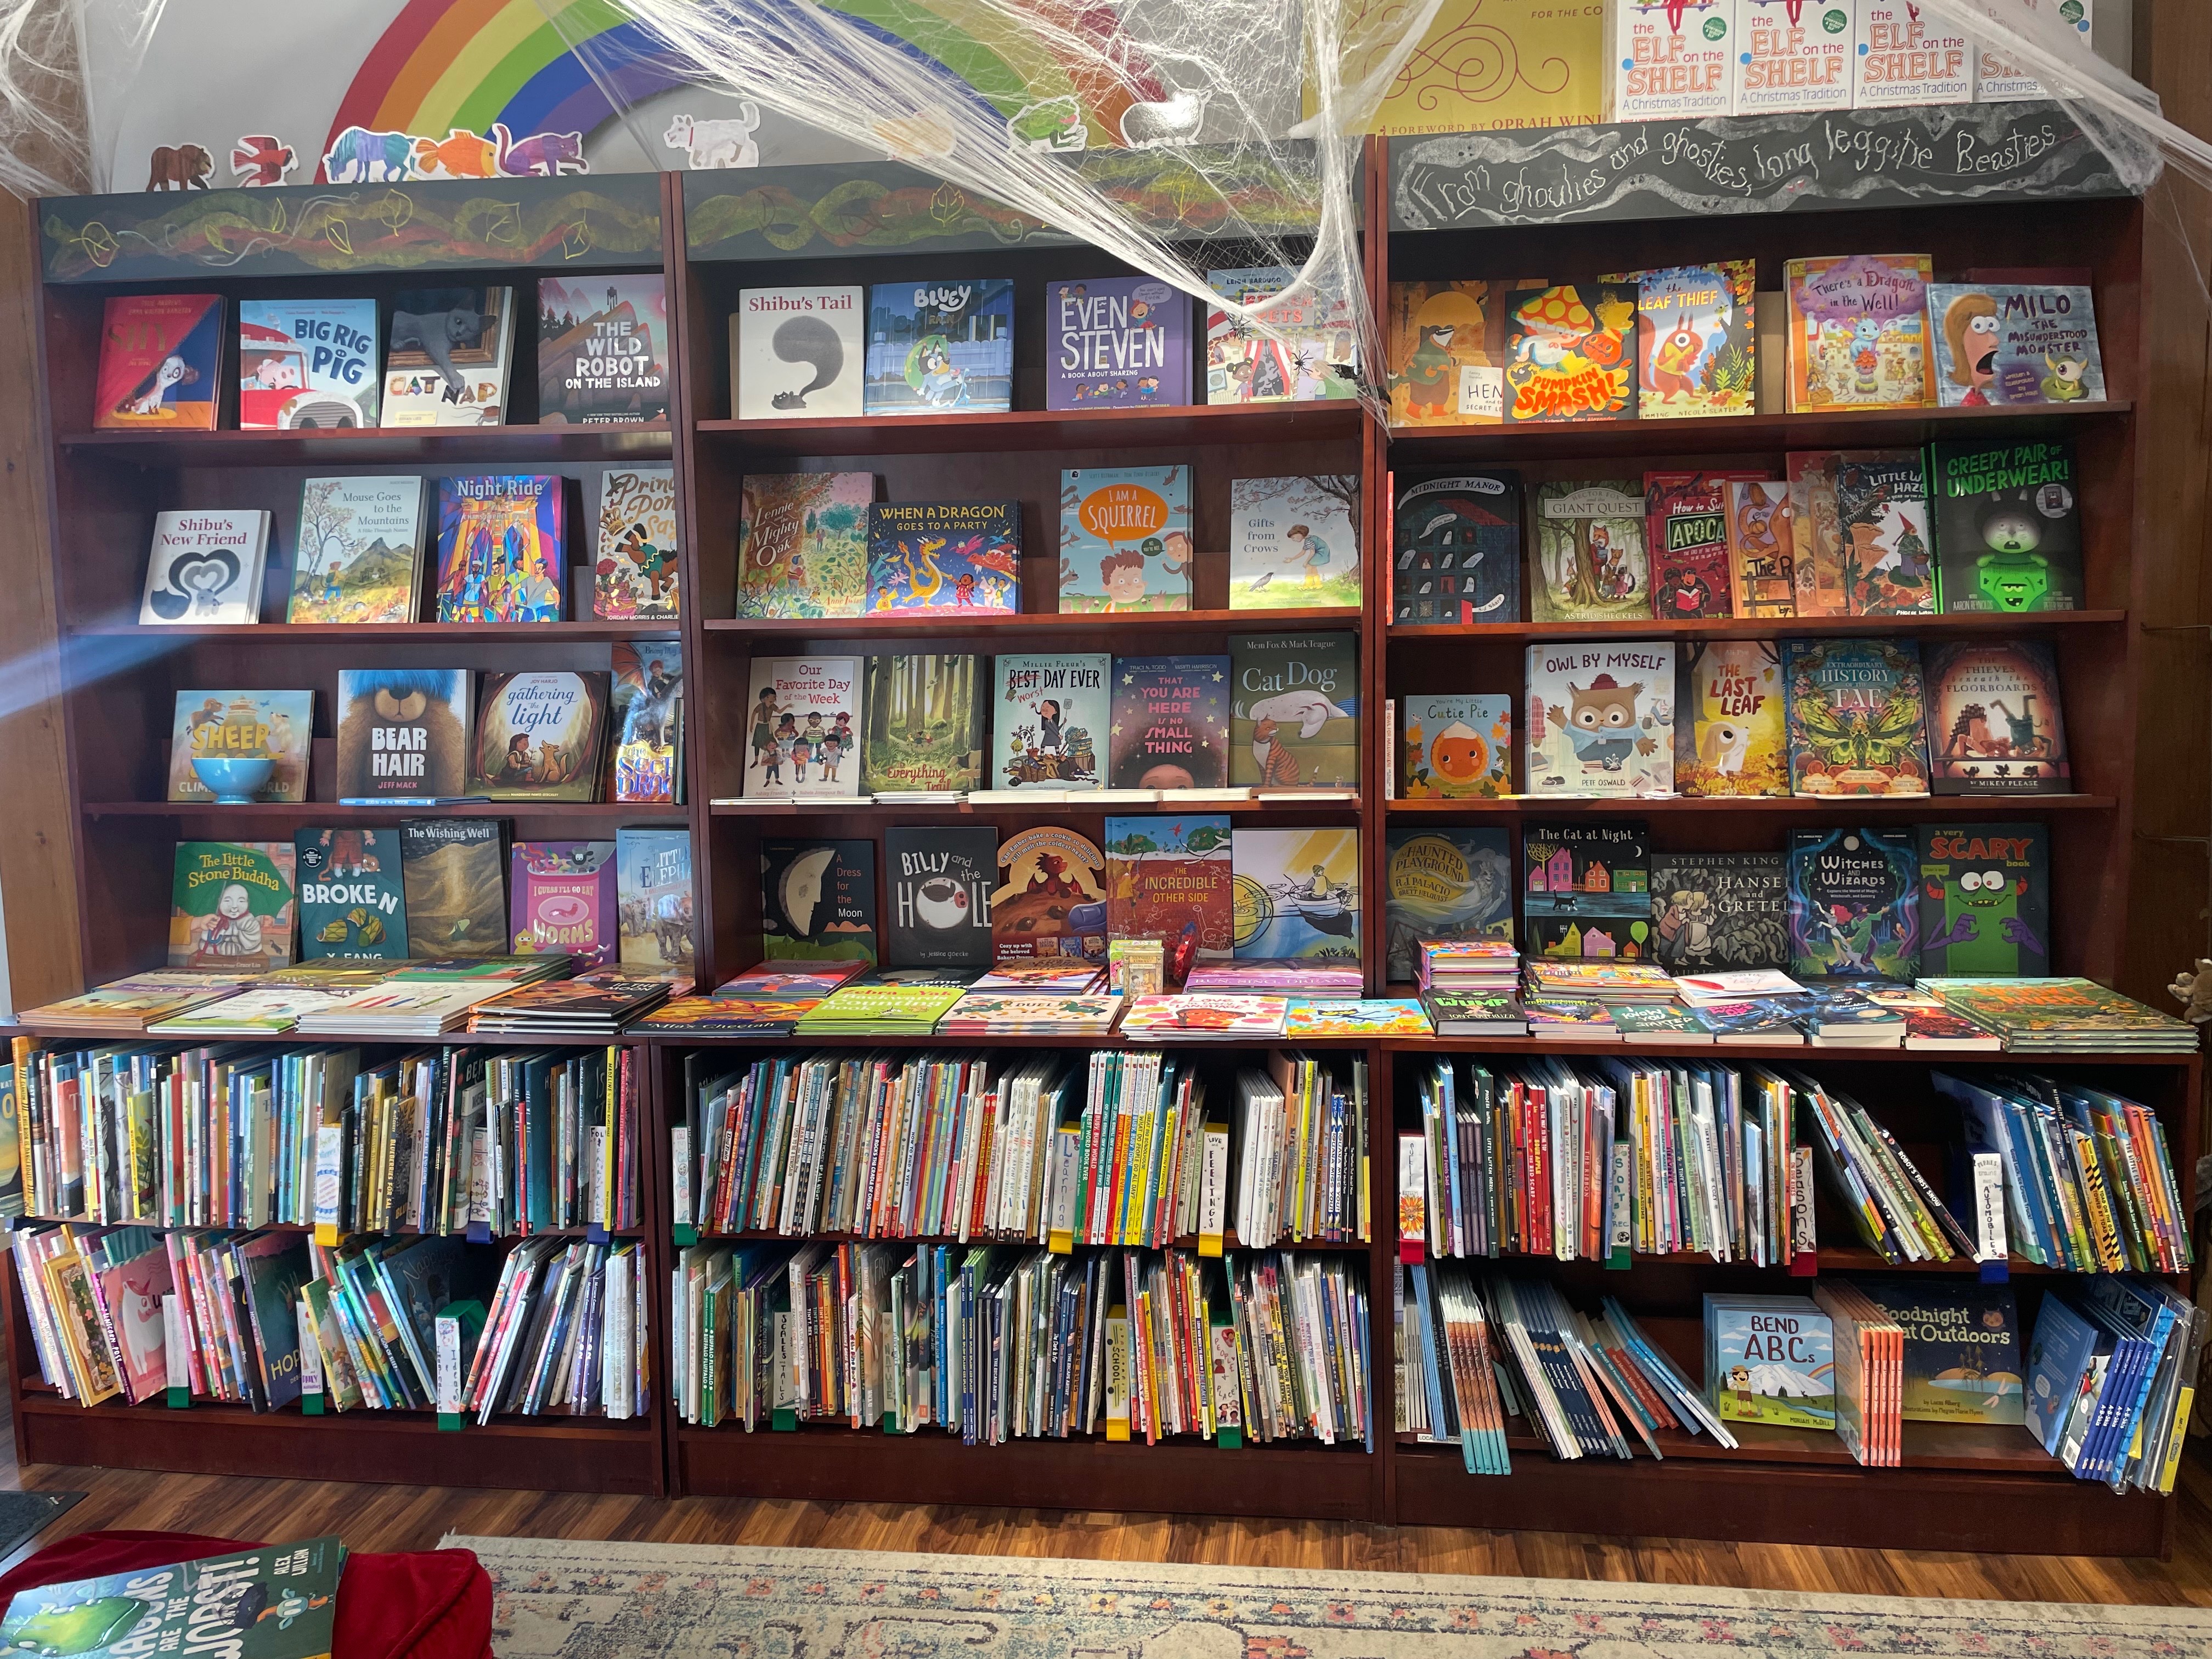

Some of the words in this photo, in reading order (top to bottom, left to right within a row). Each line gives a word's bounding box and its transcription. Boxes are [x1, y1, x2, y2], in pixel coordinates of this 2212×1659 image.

[1633, 24, 1654, 34] the
[1632, 35, 1686, 64] ELF
[1684, 52, 1698, 62] on
[1703, 50, 1724, 61] the
[1627, 64, 1723, 96] SHELF
[1391, 125, 1464, 134] FOREWORD
[1471, 123, 1486, 131] BY
[1492, 117, 1552, 130] OPRAH
[1410, 164, 1491, 221] From
[1500, 163, 1606, 213] ghoulies
[1610, 125, 1649, 170] and
[1663, 127, 1753, 196] ghosties,
[1753, 144, 1819, 180] long
[1957, 125, 2055, 173] Beasties
[748, 296, 813, 312] Shibu's
[817, 295, 852, 310] Tail
[2005, 294, 2070, 318] MILO
[1061, 296, 1127, 331] EVEN
[593, 321, 631, 336] THE
[2032, 319, 2058, 330] THE
[295, 319, 331, 341] BIG
[334, 324, 373, 354] RIG
[2008, 329, 2087, 342] MISUNDERSTOOD
[585, 337, 642, 356] WILD
[1060, 327, 1164, 370] STEVEN
[2016, 342, 2081, 356] MONSTER
[576, 356, 649, 377] ROBOT
[566, 379, 582, 388] ON
[585, 378, 612, 388] THE
[617, 376, 661, 388] ISLAND
[1532, 368, 1598, 391] PUMPKIN
[1516, 374, 1615, 415] SMASH!
[1948, 451, 2008, 476] CREEPY
[2015, 443, 2047, 465] PAIR
[2051, 445, 2062, 455] OF
[1948, 460, 2069, 498] UNDERWEAR!
[458, 480, 503, 500] Night
[507, 480, 542, 495] Ride
[1410, 481, 1462, 495] MIDNIGHT
[1464, 480, 1500, 492] MANOR
[343, 493, 374, 501] Mouse
[377, 492, 401, 501] Goes
[374, 505, 383, 513] to
[387, 504, 402, 512] the
[879, 507, 923, 520] WHEN
[927, 507, 936, 518] A
[939, 505, 1007, 518] DRAGON
[1553, 503, 1594, 514] GIANT
[1598, 503, 1640, 514] QUEST
[178, 518, 233, 531] Shibu's
[358, 516, 409, 525] Mountains
[896, 522, 923, 531] GOES
[954, 521, 988, 529] PARTY
[1088, 505, 1157, 534] SQUIRREL
[1249, 518, 1274, 528] Gifts
[161, 534, 193, 545] New
[197, 532, 247, 545] Friend
[1248, 531, 1275, 540] from
[1244, 543, 1278, 553] Crows
[1246, 641, 1264, 649] Mem
[1309, 640, 1335, 649] Teague
[799, 664, 821, 675] Our
[1547, 656, 1577, 672] OWL
[1583, 653, 1600, 668] BY
[1606, 653, 1666, 671] MYSELF
[1009, 669, 1039, 689] BEST
[1044, 669, 1066, 688] DAY
[1070, 669, 1099, 688] EVER
[1243, 668, 1284, 691] Cat
[1286, 662, 1337, 692] Dog
[1821, 669, 1891, 682] HISTORY
[775, 680, 825, 690] Favorite
[828, 679, 850, 692] Day
[1141, 687, 1169, 698] YOU
[1172, 687, 1200, 698] ARE
[1946, 684, 2037, 692] FLOORBOARDS
[506, 686, 578, 705] gathering
[809, 693, 840, 704] Week
[1835, 689, 1883, 708] FAE
[1148, 702, 1191, 713] HERE
[1428, 706, 1464, 718] Cutie
[1470, 705, 1488, 718] Pie
[512, 703, 562, 732] light
[372, 727, 427, 751] BEAR
[1144, 727, 1192, 738] SMALL
[1144, 742, 1192, 753] THING
[373, 753, 425, 776] HAIR
[408, 828, 425, 838] The
[426, 828, 466, 839] Wishing
[469, 828, 489, 838] Well
[1539, 829, 1559, 840] The
[1564, 830, 1580, 840] Cat
[1586, 830, 1598, 840] at
[1602, 830, 1633, 843] Night
[1929, 838, 2033, 859] SCARY
[199, 855, 219, 868] The
[223, 853, 255, 867] Little
[901, 852, 949, 876] BILLY
[951, 855, 972, 868] and
[188, 868, 230, 889] Stone
[231, 867, 279, 890] Buddha
[837, 868, 861, 877] Dress
[1144, 877, 1218, 890] INCREDIBLE
[1153, 893, 1184, 902] OTHER
[1188, 893, 1208, 902] SIDE
[838, 908, 862, 917] Moon
[1898, 1151, 1916, 1175] ROBOT'S
[1915, 1172, 1927, 1189] FIRST
[1926, 1187, 1940, 1207] SNOW
[1983, 1186, 1997, 1255] AUTOMOBILES
[1751, 1316, 1798, 1333] BEND
[1921, 1323, 2010, 1345] Outdoors
[1743, 1334, 1815, 1363] ABCs
[273, 1555, 291, 1575] ALEX
[291, 1548, 309, 1576] WILLAN
